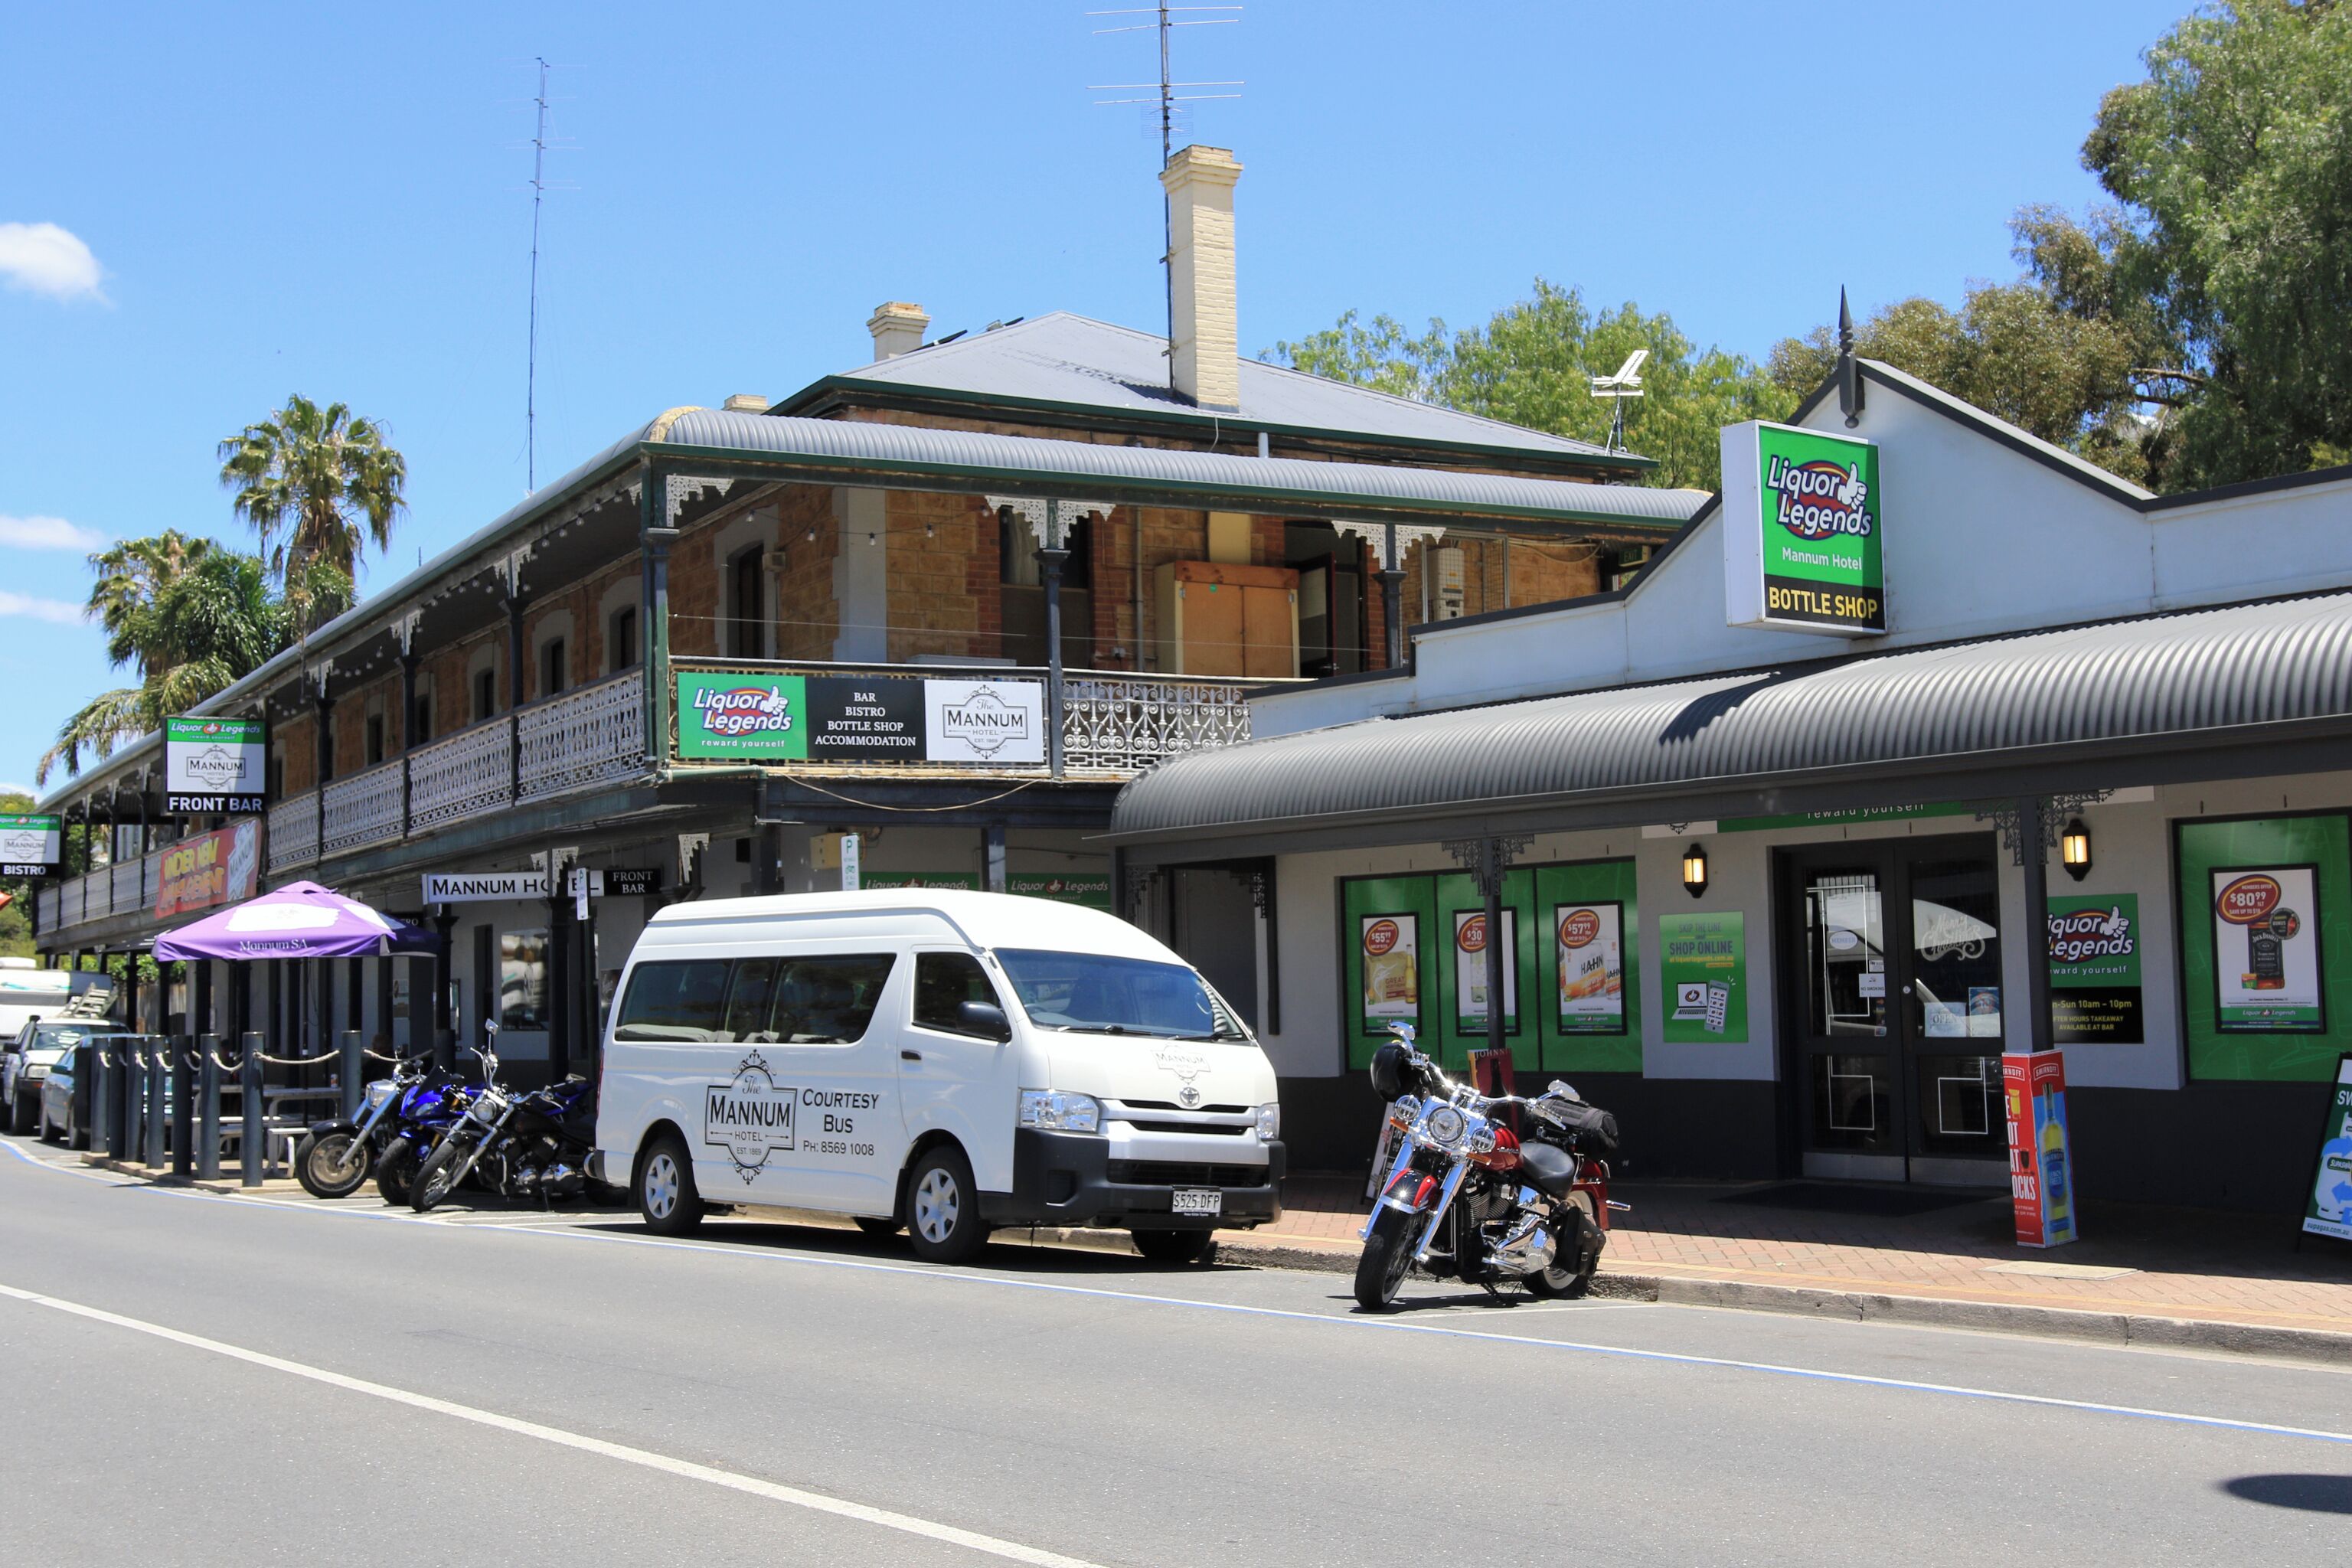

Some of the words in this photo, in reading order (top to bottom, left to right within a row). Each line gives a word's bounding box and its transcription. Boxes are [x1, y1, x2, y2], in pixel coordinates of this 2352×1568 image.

[1767, 456, 1840, 500] Liquor
[1778, 494, 1873, 536] Legends
[1782, 547, 1830, 567] Mannum
[1832, 554, 1863, 570] Hotel
[1769, 586, 1832, 616] BOTTLE
[1834, 595, 1878, 619] SHOP
[693, 688, 763, 714] Liquor
[853, 692, 877, 703] BAR
[976, 698, 994, 710] The
[844, 706, 886, 717] BISTRO
[703, 710, 792, 734] Legends
[947, 710, 1023, 727] MANNUM
[171, 722, 203, 733] Liquor
[220, 724, 261, 735] Legends
[827, 720, 871, 731] BOTTLE
[874, 721, 904, 732] SHOP
[701, 739, 738, 747] reward
[742, 740, 786, 749] yourself
[815, 735, 916, 746] ACCOMMODATION
[190, 760, 243, 771] MANNUM
[168, 797, 225, 811] FRONT
[230, 798, 262, 811] BAR
[3, 865, 46, 875] BISTRO
[612, 871, 654, 882] FRONT
[433, 878, 515, 897] MANNUM
[622, 883, 646, 894] BAR
[1011, 880, 1046, 893] Liquor
[1065, 880, 1109, 893] Legends
[2048, 913, 2102, 939] iquor
[1466, 929, 1482, 941] $30
[239, 940, 289, 952] Mannum
[290, 938, 308, 950] SA
[1669, 941, 1695, 956] SHOP
[1697, 940, 1733, 955] ONLINE
[1580, 953, 1604, 976] HAHN
[2050, 966, 2078, 975] ward
[2082, 965, 2128, 976] yourself
[2052, 1000, 2076, 1009] n-Sun
[2078, 999, 2100, 1008] 10am
[2109, 999, 2132, 1010] 10pm
[1155, 1053, 1206, 1064] MANNUM
[2035, 1065, 2057, 1077] SMIRNOFF
[742, 1075, 762, 1095] The
[802, 1088, 880, 1109] COURTESY
[710, 1095, 791, 1128] MANNUM
[823, 1114, 854, 1133] BUS
[734, 1131, 763, 1142] HOTEL
[749, 1148, 762, 1156] 1869
[803, 1140, 819, 1153] PH:
[821, 1141, 847, 1154] 8569
[850, 1143, 874, 1156] 1008
[2011, 1174, 2037, 1200] OCKS
[2307, 1223, 2350, 1236] supagas.com.au
